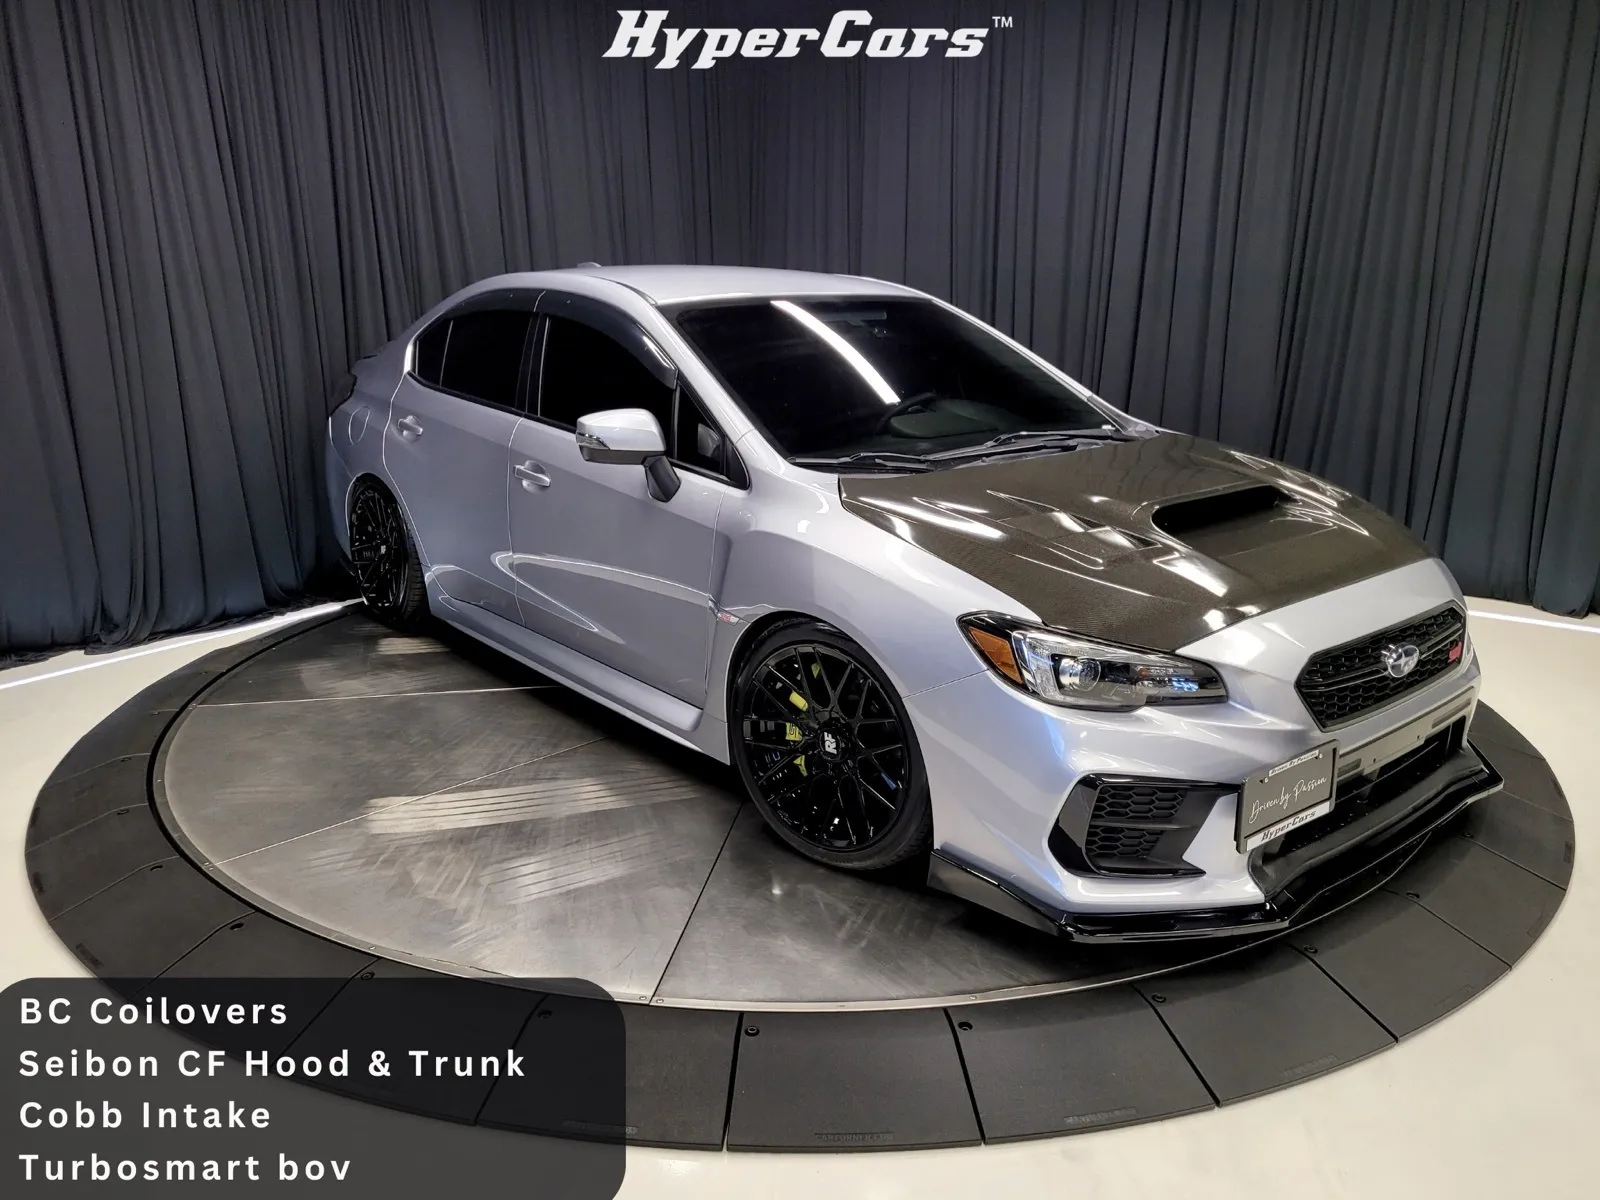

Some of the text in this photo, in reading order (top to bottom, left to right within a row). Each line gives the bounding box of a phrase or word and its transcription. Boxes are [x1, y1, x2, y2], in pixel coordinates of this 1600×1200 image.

[1249, 799, 1280, 824] Driven
[1293, 777, 1327, 802] Passion
[1261, 810, 1316, 842] HyperCars
